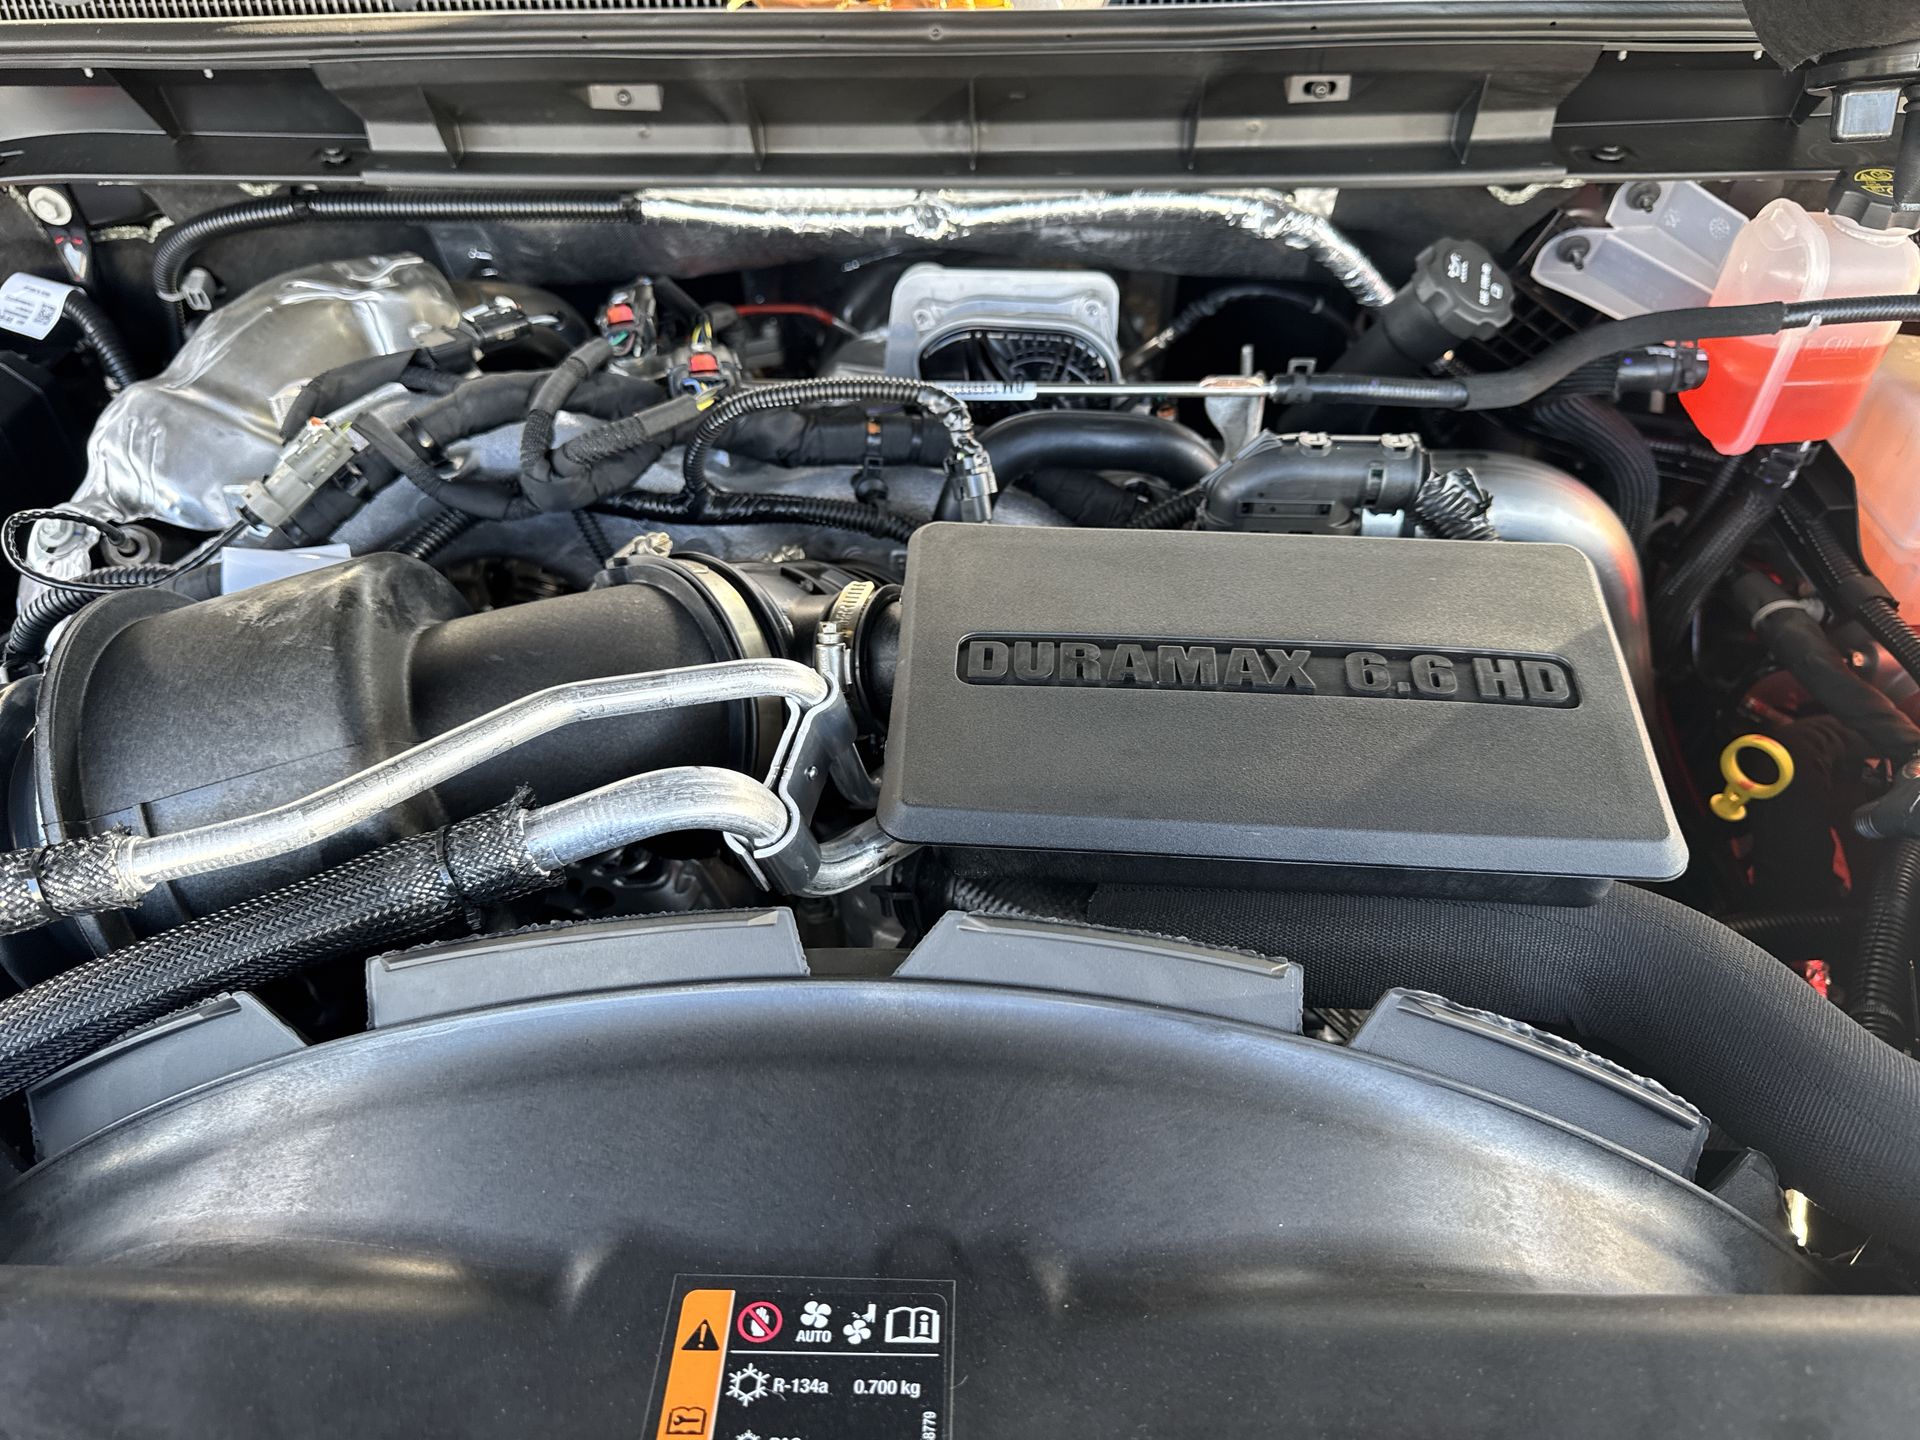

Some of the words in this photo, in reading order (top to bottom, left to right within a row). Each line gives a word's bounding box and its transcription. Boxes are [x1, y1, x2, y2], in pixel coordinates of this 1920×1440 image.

[966, 639, 1317, 692] DURAMAX
[1345, 650, 1458, 698] 6.6
[1472, 657, 1572, 703] HD
[795, 1329, 832, 1343] AUTO
[772, 1377, 829, 1395] R-134a
[853, 1379, 898, 1395] 0.700
[900, 1379, 921, 1399] kg
